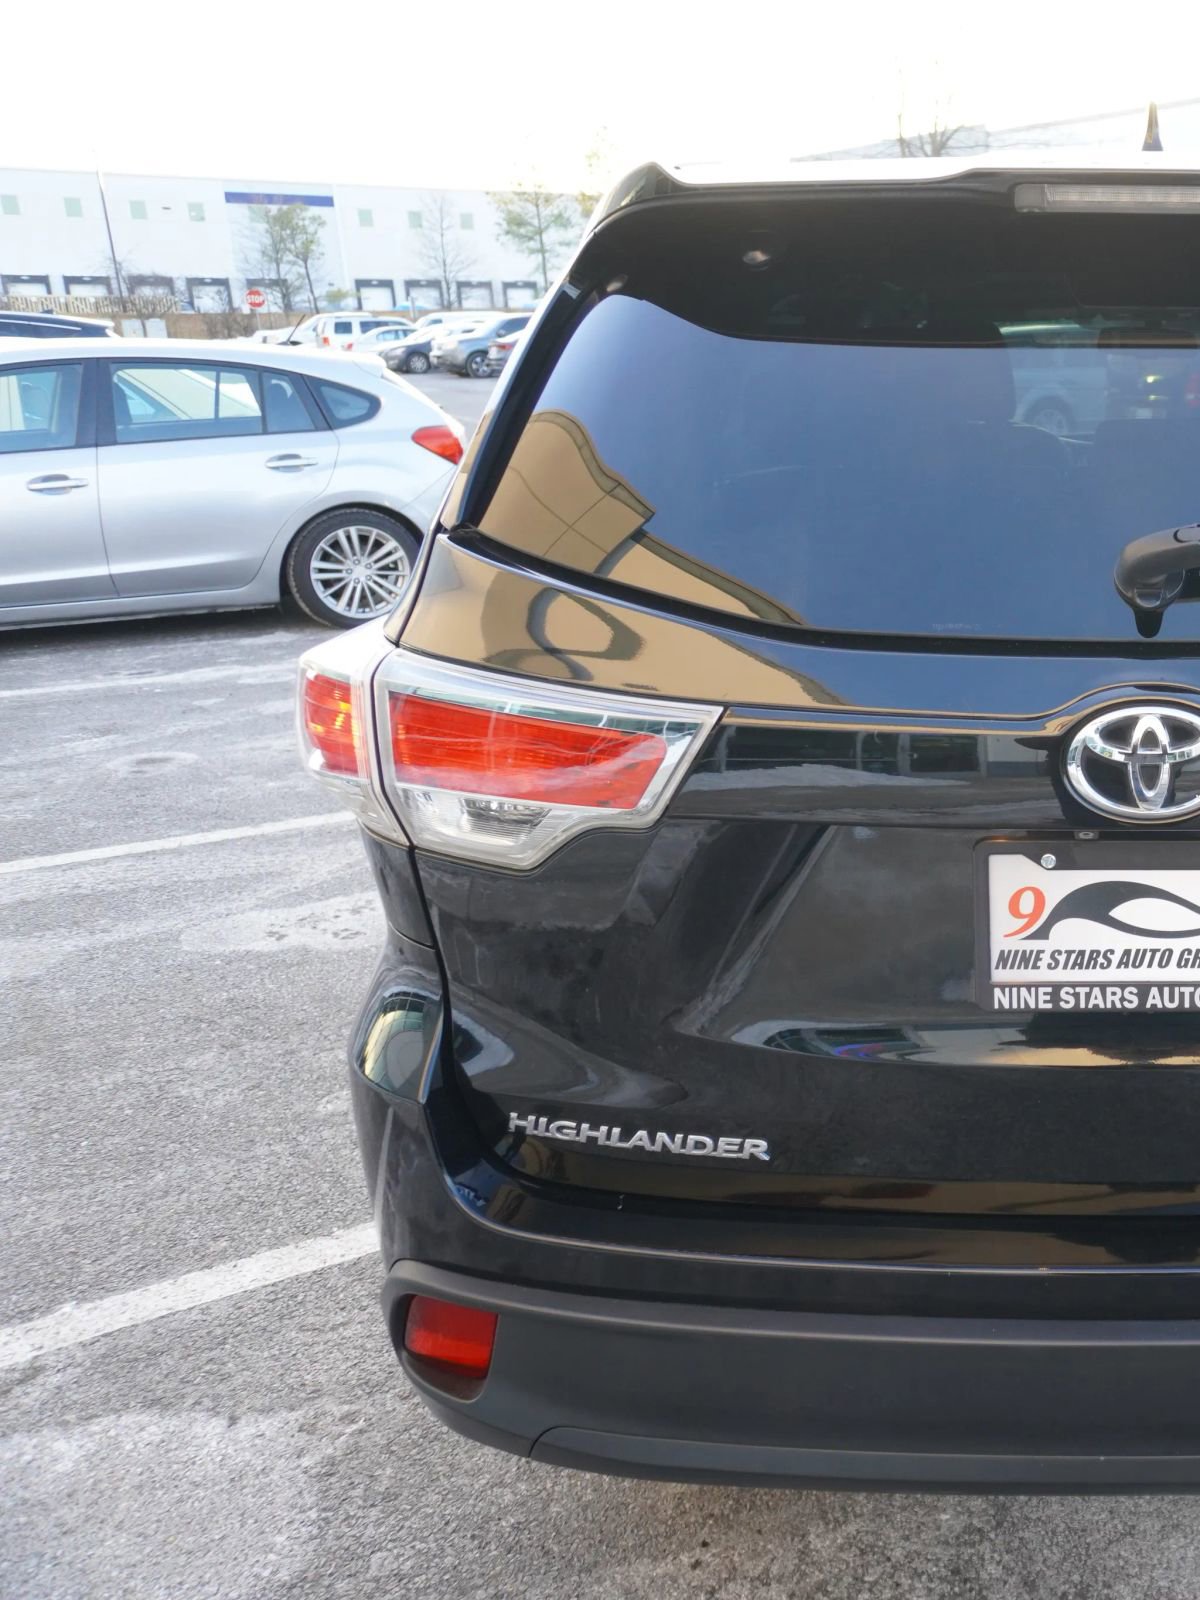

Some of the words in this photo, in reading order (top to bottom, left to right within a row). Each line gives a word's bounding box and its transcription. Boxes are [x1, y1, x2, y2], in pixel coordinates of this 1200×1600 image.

[246, 294, 265, 304] STOP
[1003, 886, 1046, 938] 9
[994, 949, 1045, 970] NINE
[1047, 948, 1114, 970] STARS
[1116, 948, 1176, 969] AUTO
[993, 987, 1053, 1010] NINE
[1059, 986, 1139, 1009] STARS
[508, 1112, 771, 1161] HIGHLANDER
